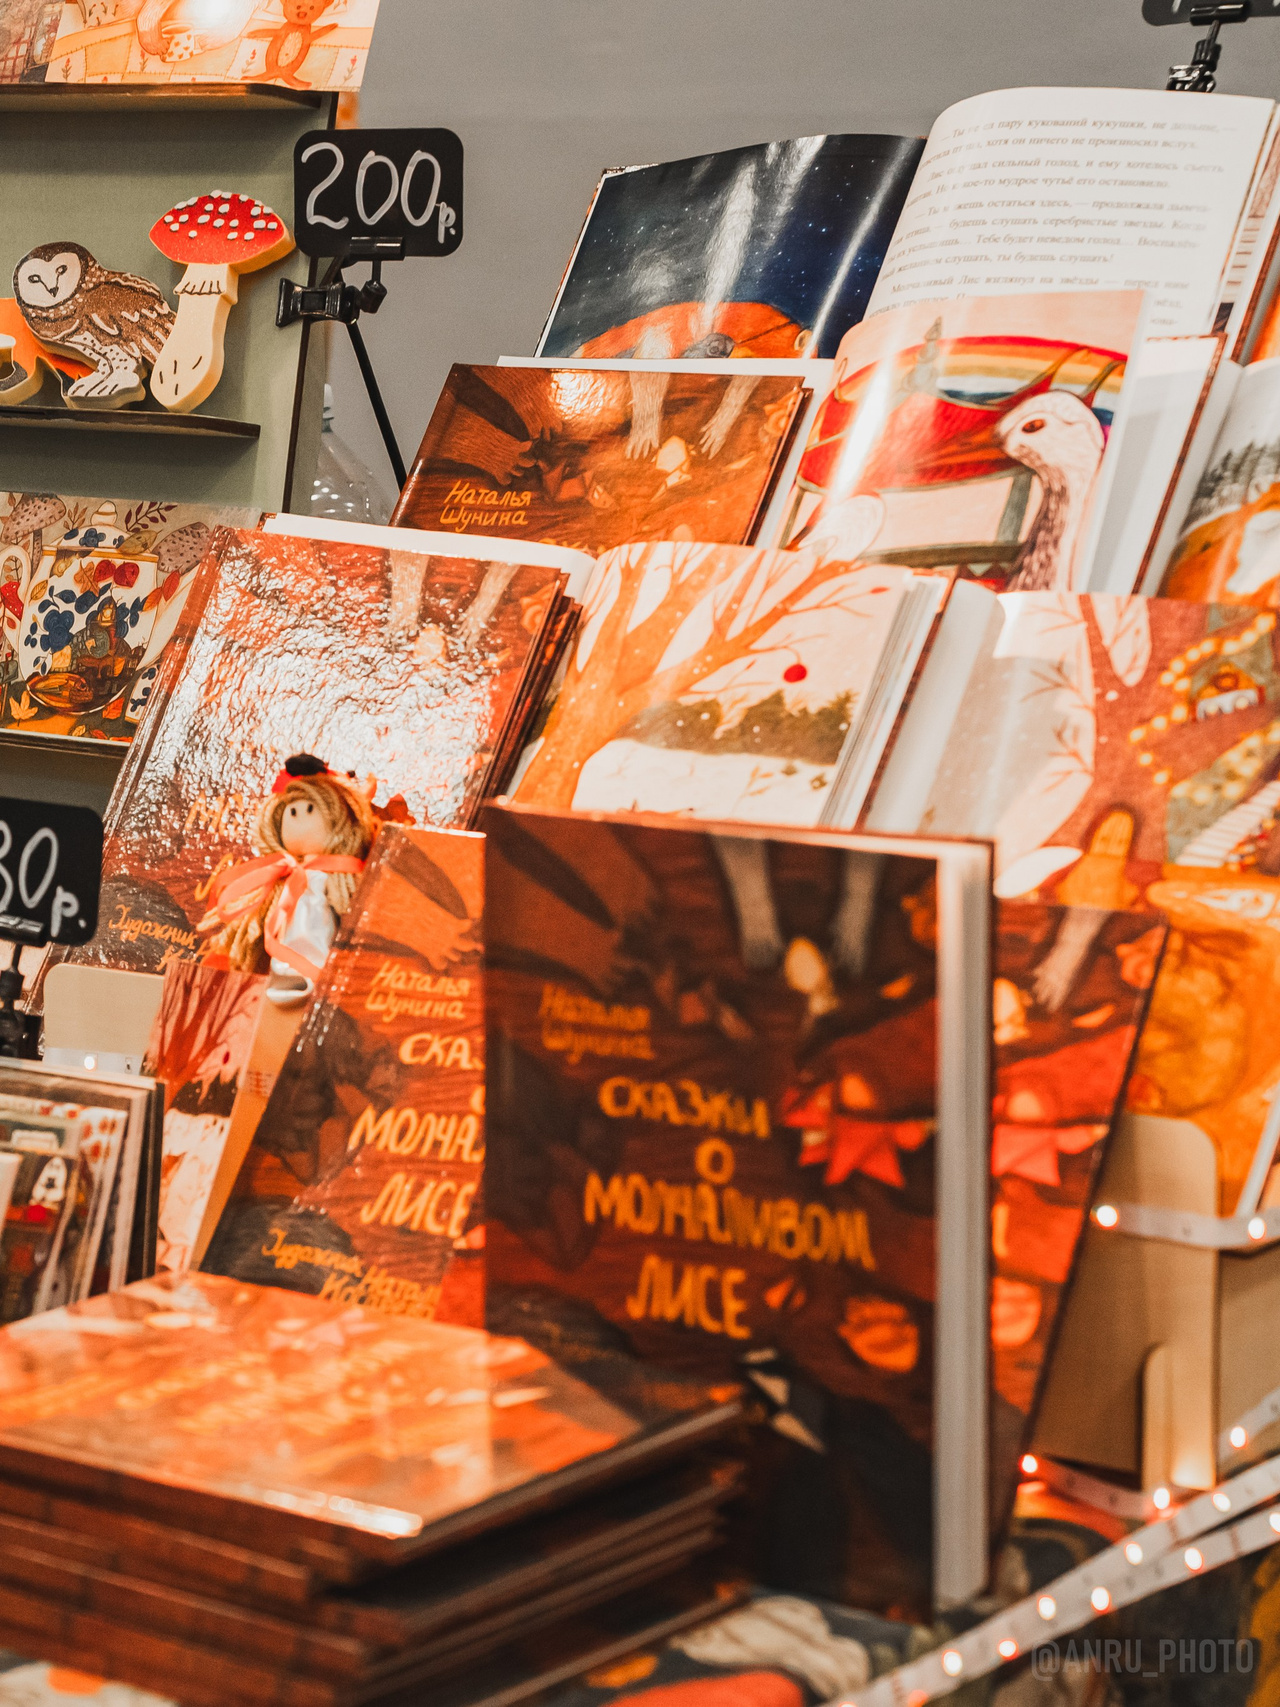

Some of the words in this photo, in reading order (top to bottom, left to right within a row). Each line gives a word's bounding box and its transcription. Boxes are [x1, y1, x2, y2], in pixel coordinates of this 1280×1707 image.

[987, 137, 1008, 146] хотя
[998, 119, 1023, 130] пару
[1151, 121, 1166, 130] не
[1098, 160, 1122, 170] ему
[301, 142, 456, 243] 200р.
[443, 480, 532, 507] Наталья
[440, 505, 529, 533] Шунина
[370, 960, 470, 997] Наталья
[365, 988, 466, 1023] Шунина
[399, 1032, 486, 1071] СКА
[347, 1103, 485, 1163] МОЛЧА
[694, 1137, 735, 1184] О
